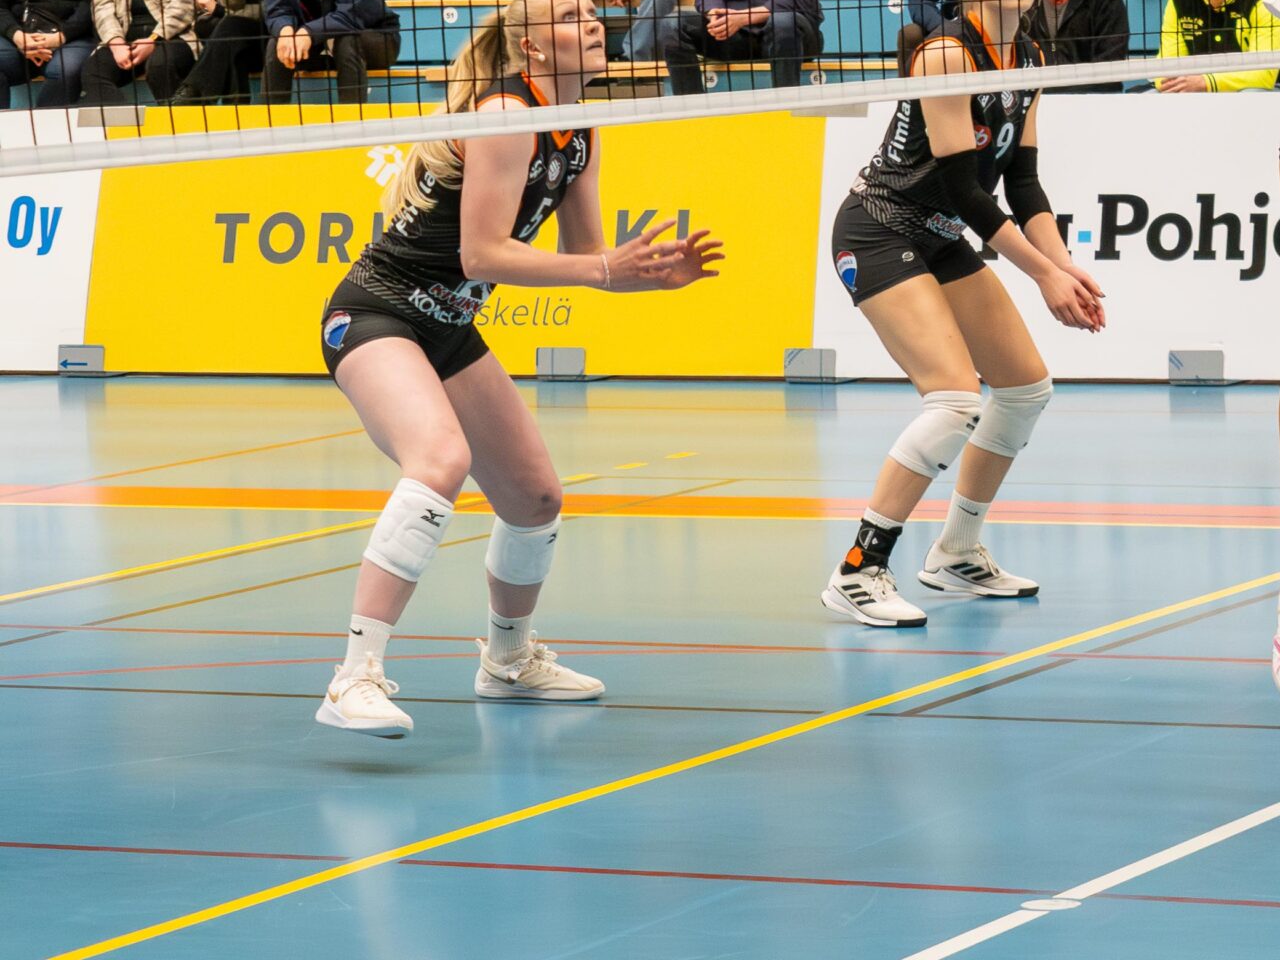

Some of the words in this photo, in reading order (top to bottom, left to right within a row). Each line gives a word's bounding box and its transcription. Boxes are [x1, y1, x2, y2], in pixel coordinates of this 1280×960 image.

[886, 96, 912, 164] Fimla
[7, 195, 63, 256] Oy
[477, 296, 572, 326] skellä
